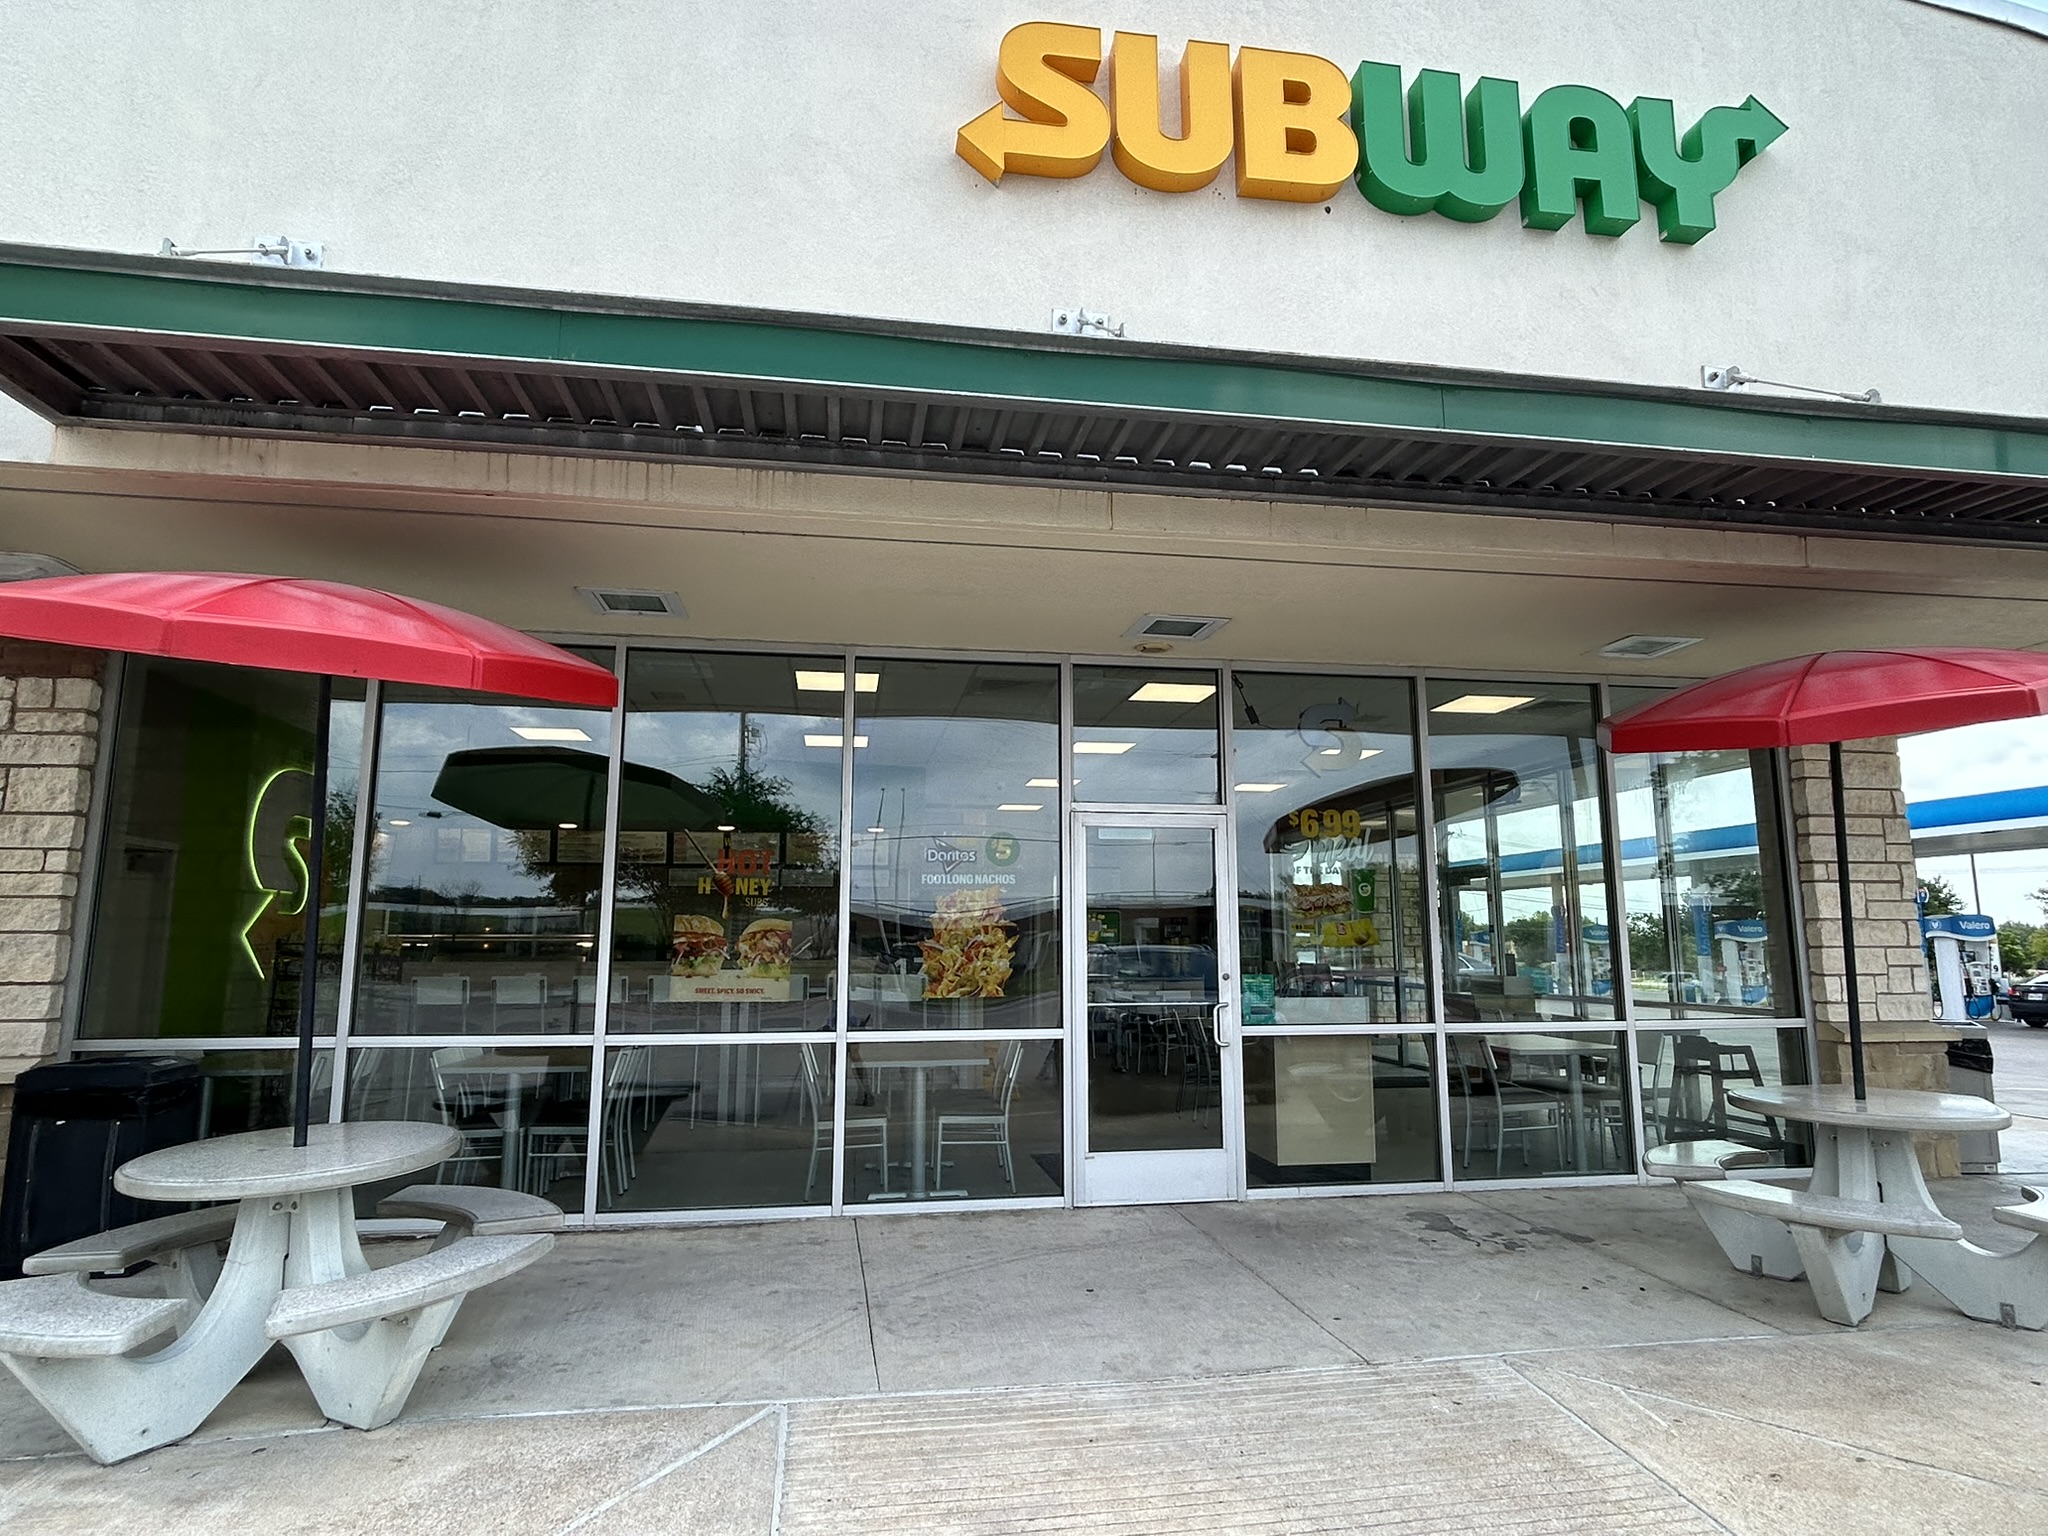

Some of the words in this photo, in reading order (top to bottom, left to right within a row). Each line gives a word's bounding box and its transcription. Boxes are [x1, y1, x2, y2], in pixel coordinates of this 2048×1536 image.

[956, 20, 1789, 246] SUBWAY
[926, 848, 977, 862] Doritos
[717, 848, 776, 876] HOT
[921, 873, 973, 885] FOOTLONG
[975, 874, 1016, 885] NACHOS
[698, 877, 773, 896] HNEY
[1737, 925, 1763, 933] Valero
[1959, 921, 1990, 930] Valero
[1993, 964, 1999, 973] 9
